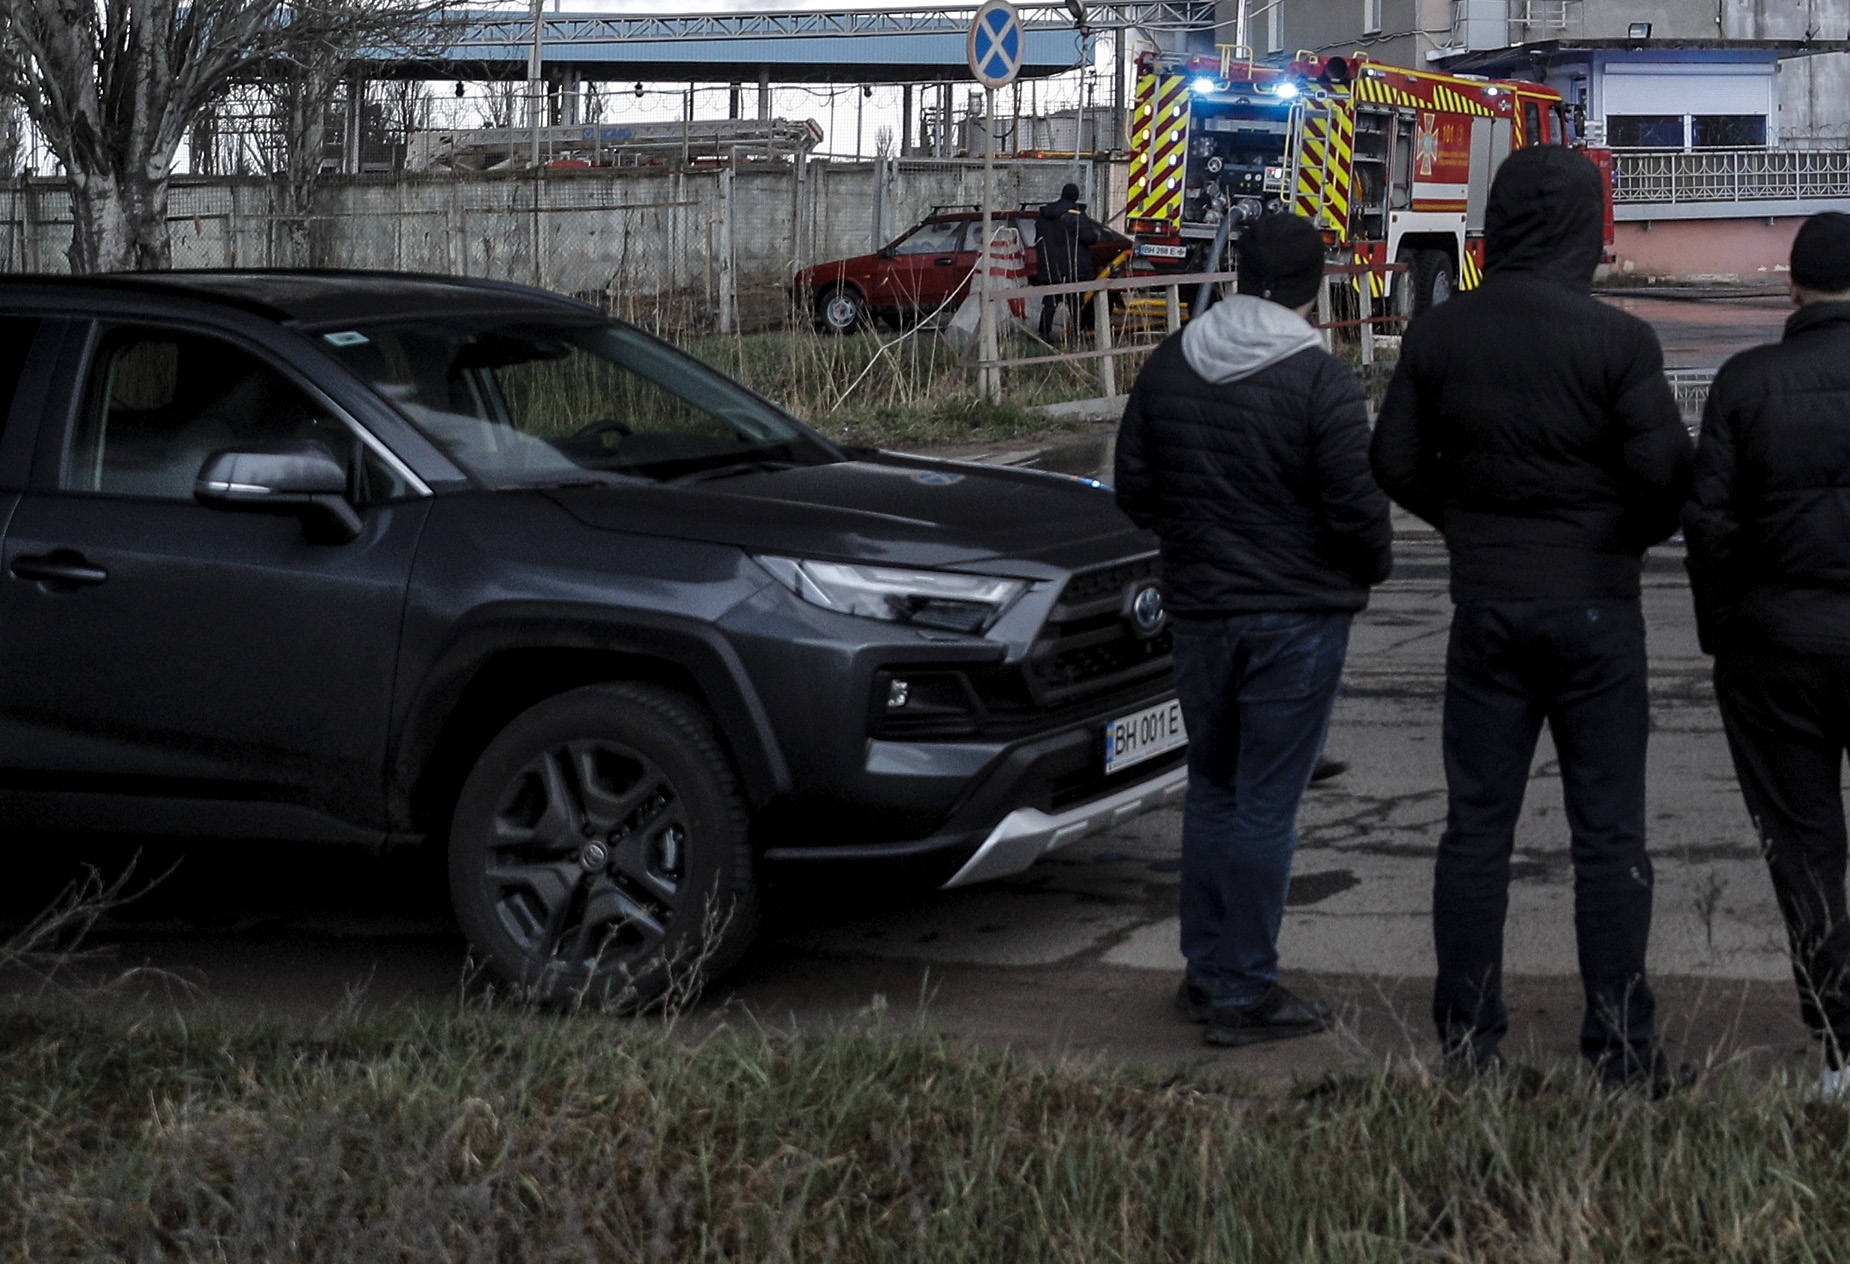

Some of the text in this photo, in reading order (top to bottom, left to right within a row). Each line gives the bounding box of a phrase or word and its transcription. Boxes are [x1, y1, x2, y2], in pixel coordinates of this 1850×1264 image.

[1115, 720, 1137, 755] BH
[1141, 710, 1165, 745] 001
[1169, 703, 1179, 735] E
